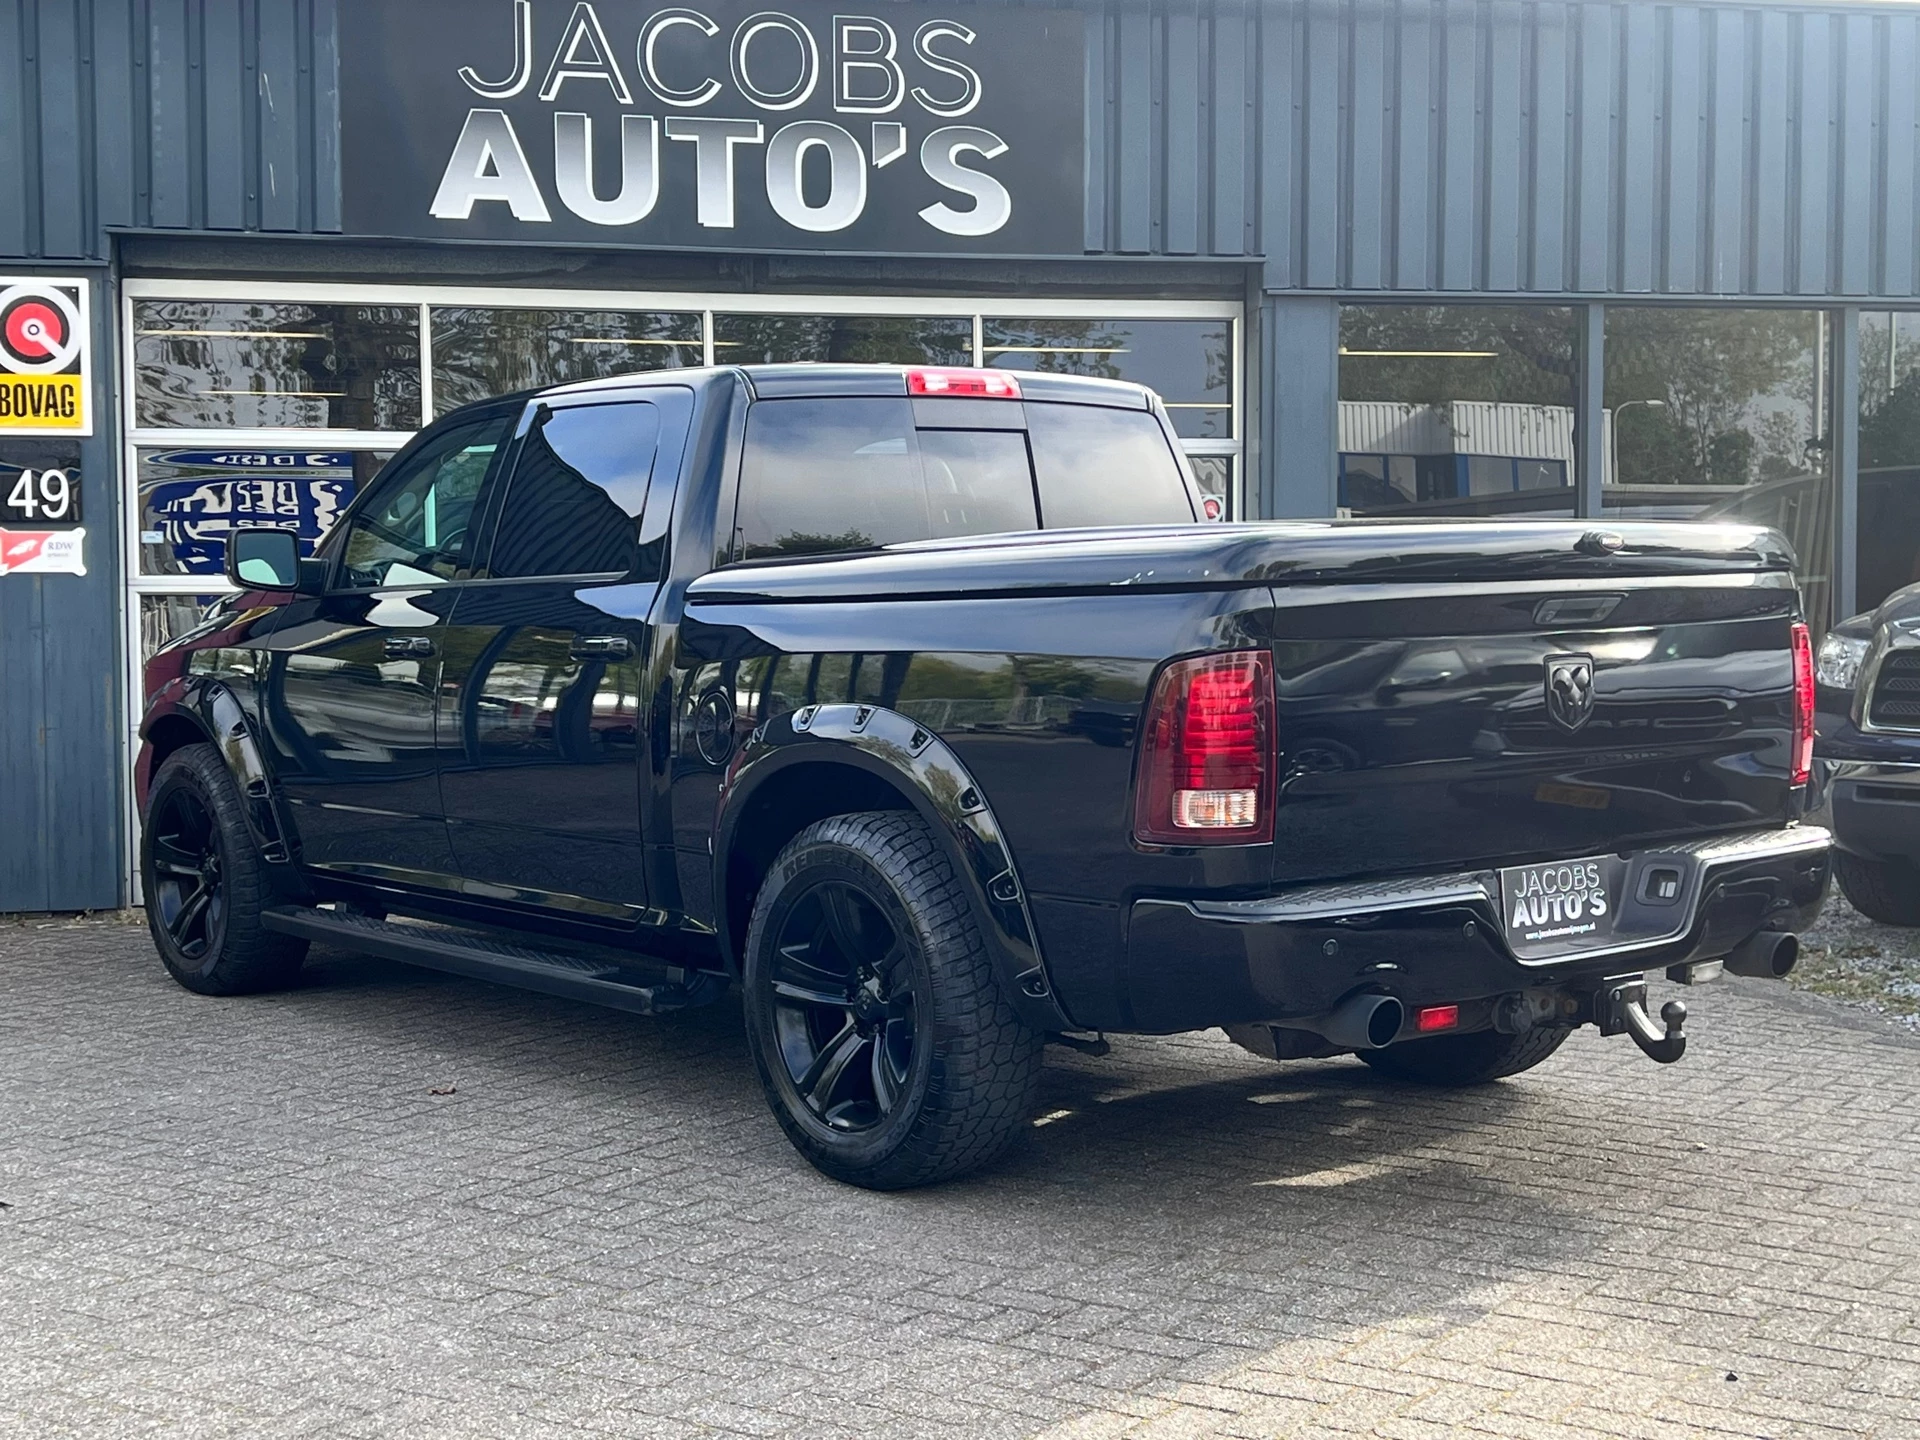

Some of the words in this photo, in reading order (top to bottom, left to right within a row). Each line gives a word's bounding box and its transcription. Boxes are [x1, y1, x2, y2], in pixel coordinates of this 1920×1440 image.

[457, 0, 982, 117] JACOBS
[429, 108, 1011, 237] AUTO'S
[0, 383, 75, 418] BOVAG
[7, 469, 70, 519] 49
[1514, 862, 1600, 898] JACOBS
[1512, 888, 1607, 928] AUTO'S
